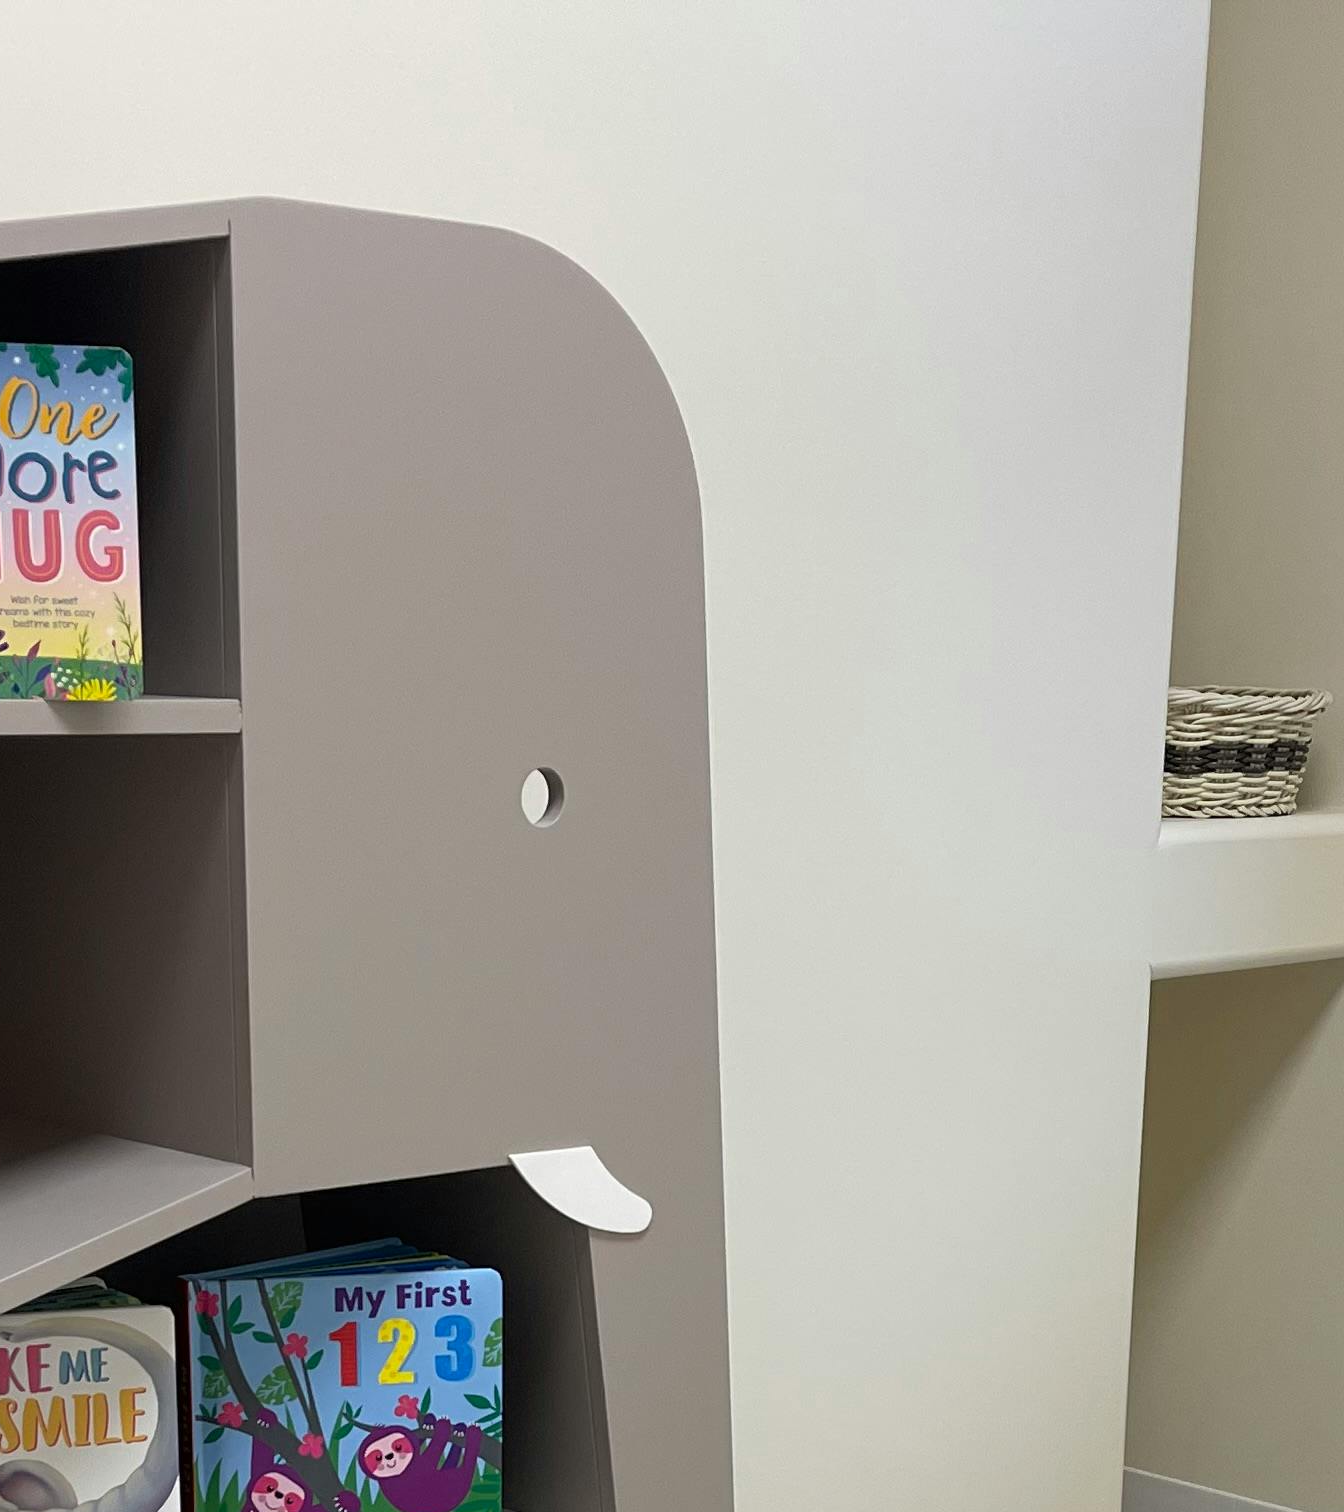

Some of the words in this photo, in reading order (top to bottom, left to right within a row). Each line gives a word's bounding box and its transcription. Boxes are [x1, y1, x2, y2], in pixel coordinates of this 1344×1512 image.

[13, 619, 50, 628] bedtime
[52, 620, 78, 630] story
[32, 608, 52, 617] with
[55, 608, 72, 617] this
[74, 610, 96, 618] cozy
[334, 1286, 386, 1319] My
[396, 1279, 472, 1310] First
[59, 1347, 110, 1385] ME
[328, 1321, 359, 1387] 1
[377, 1317, 417, 1385] 2
[434, 1314, 475, 1382] 3
